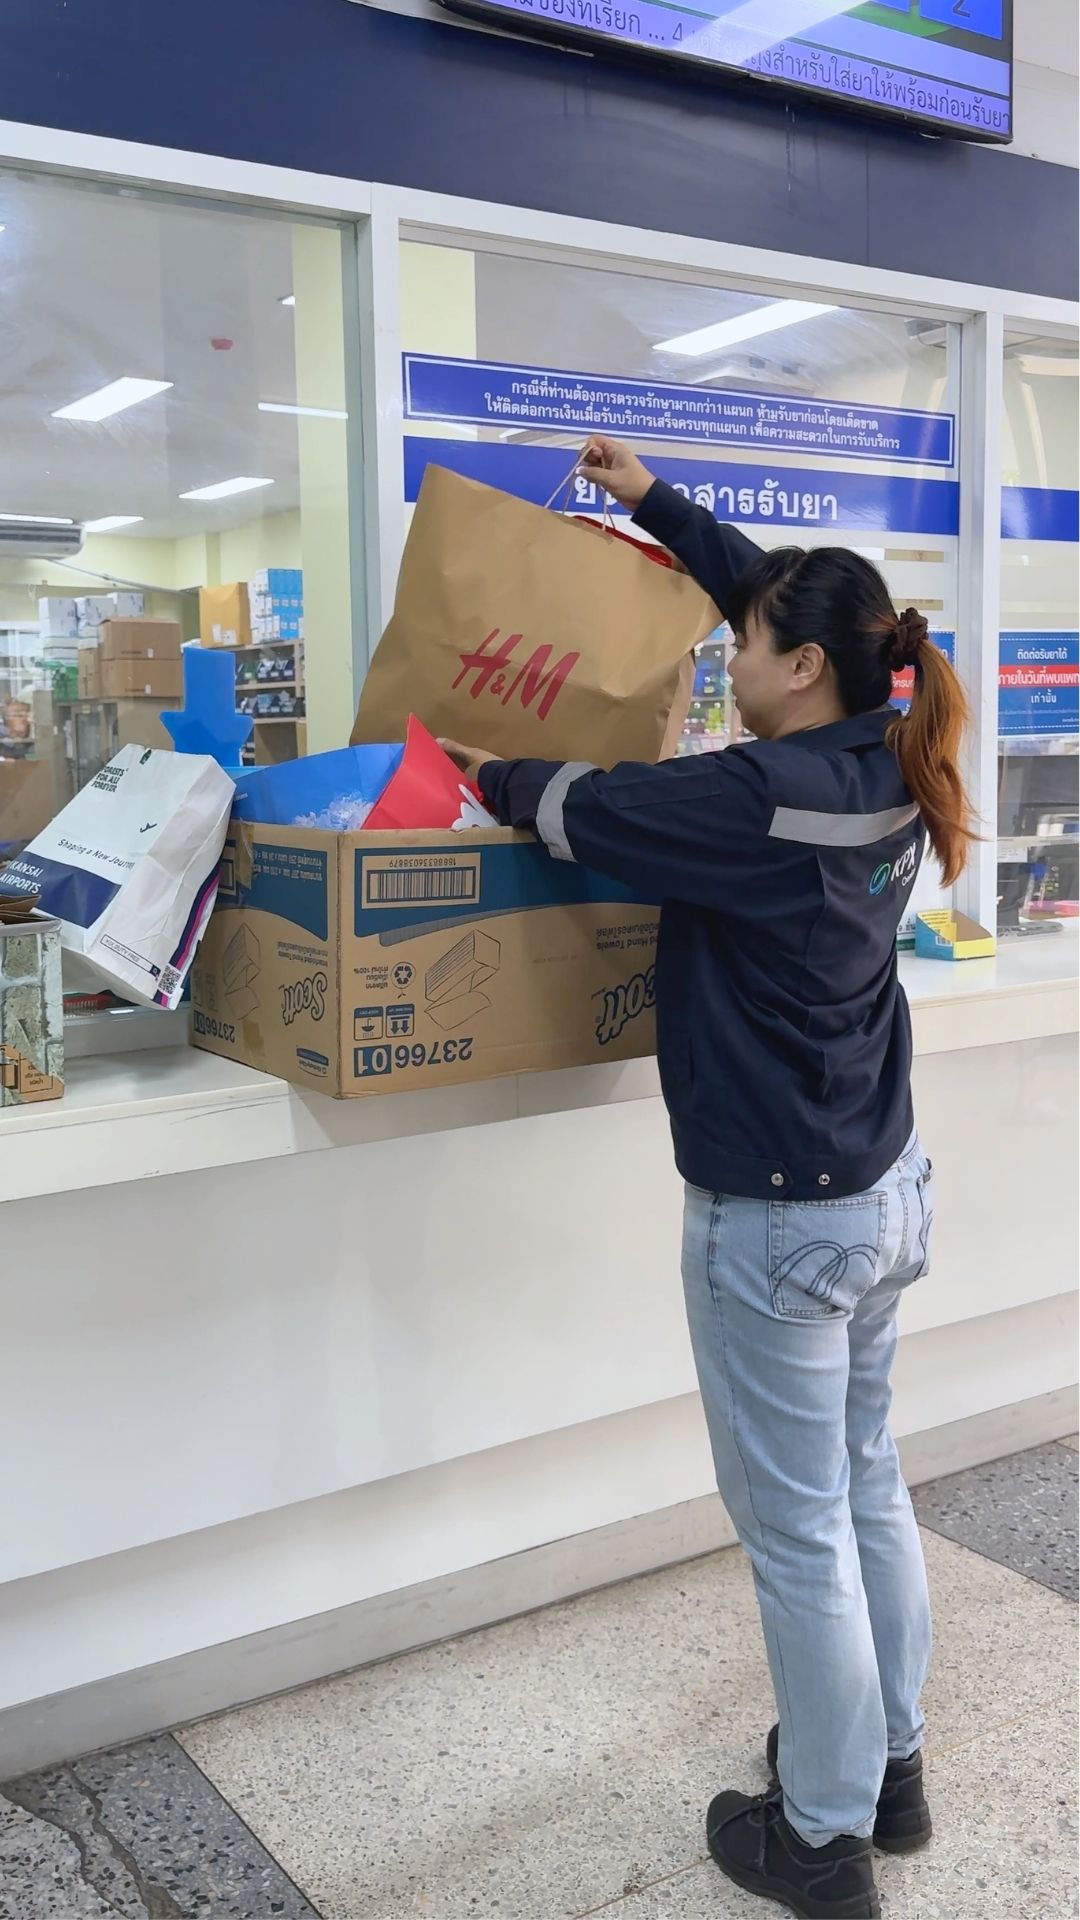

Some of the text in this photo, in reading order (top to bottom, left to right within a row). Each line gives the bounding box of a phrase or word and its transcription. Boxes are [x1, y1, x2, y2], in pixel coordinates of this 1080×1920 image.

[750, 420, 900, 450] เพื่อความสะดวกในการรับบริการ
[452, 628, 581, 721] H&M
[1031, 689, 1057, 704] เท่านั้น
[57, 838, 87, 855] Shaping
[93, 850, 109, 860] New
[890, 841, 916, 882] KPX
[10, 860, 43, 878] KANSAI
[281, 971, 329, 1026] Scott
